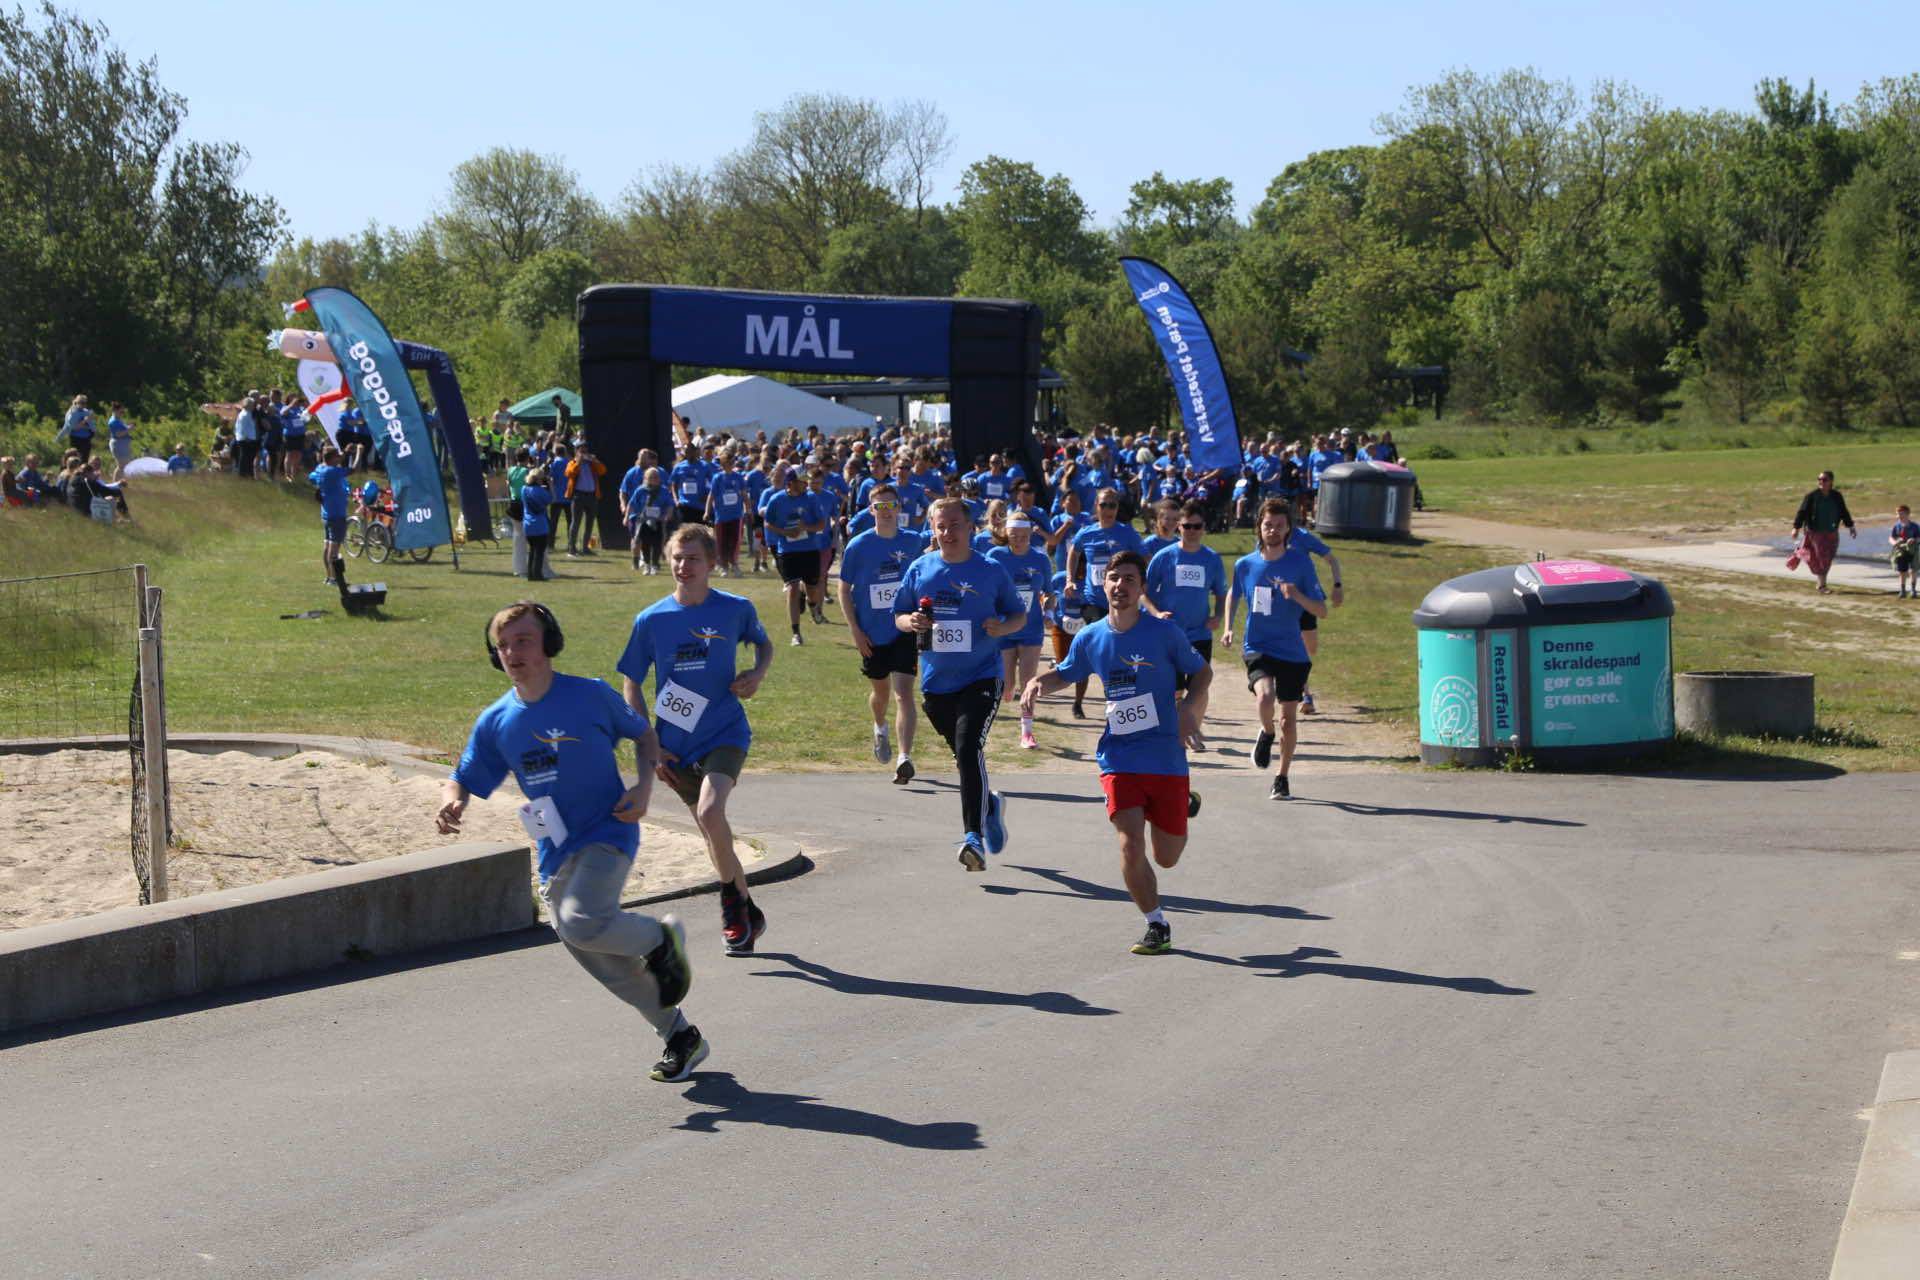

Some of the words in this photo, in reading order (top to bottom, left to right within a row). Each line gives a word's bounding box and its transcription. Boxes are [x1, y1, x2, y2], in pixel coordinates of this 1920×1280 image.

[745, 304, 855, 359] MÅL
[1182, 570, 1201, 581] 359
[937, 629, 964, 643] 363
[1543, 640, 1594, 653] Denne
[1544, 653, 1641, 670] skraldespand
[1494, 646, 1510, 729] Restaffald
[1544, 676, 1571, 692] gør
[1576, 676, 1594, 687] os
[1597, 671, 1623, 686] alle
[661, 691, 695, 718] 366
[1544, 692, 1620, 709] grønnere.
[1116, 704, 1148, 725] 365
